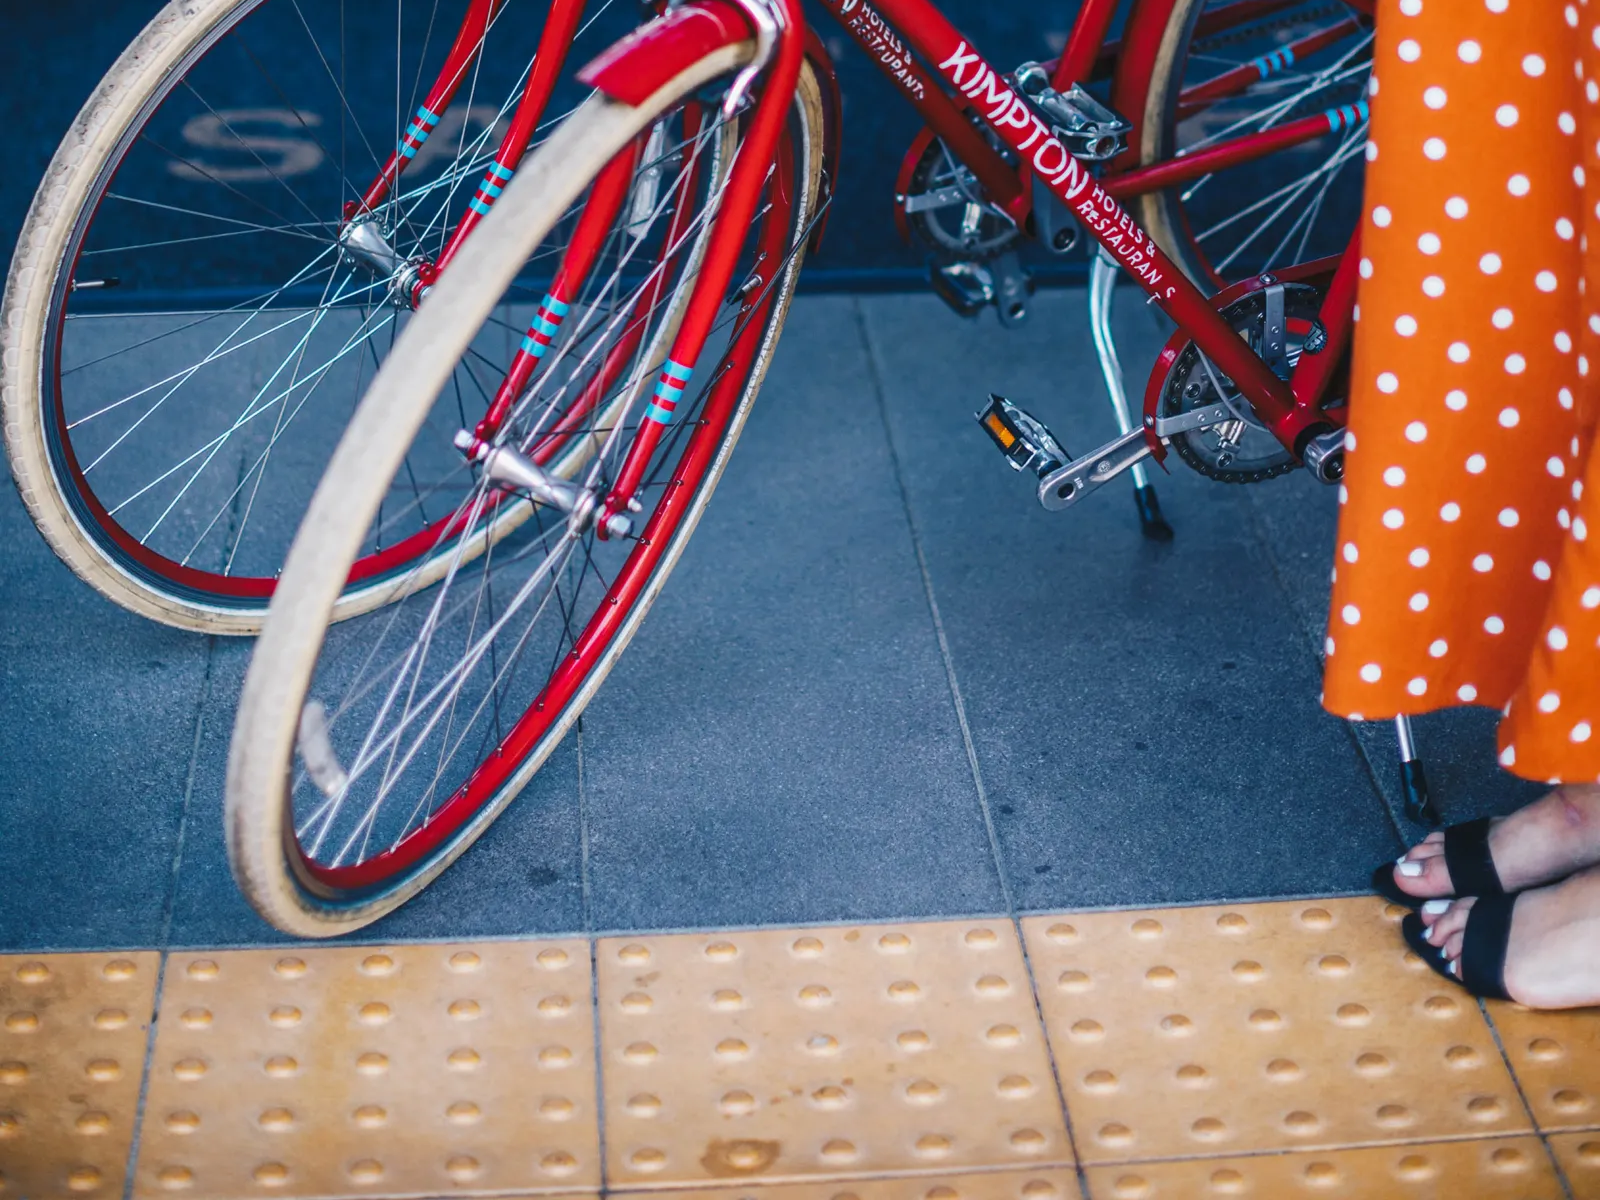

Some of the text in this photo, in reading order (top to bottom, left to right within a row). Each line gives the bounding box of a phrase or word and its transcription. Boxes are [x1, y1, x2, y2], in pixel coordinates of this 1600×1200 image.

[848, 15, 924, 100] RESTAURANTS
[861, 1, 902, 53] HOTELS
[938, 41, 1090, 200] KIMPTON
[1092, 184, 1155, 257] HOTELS &
